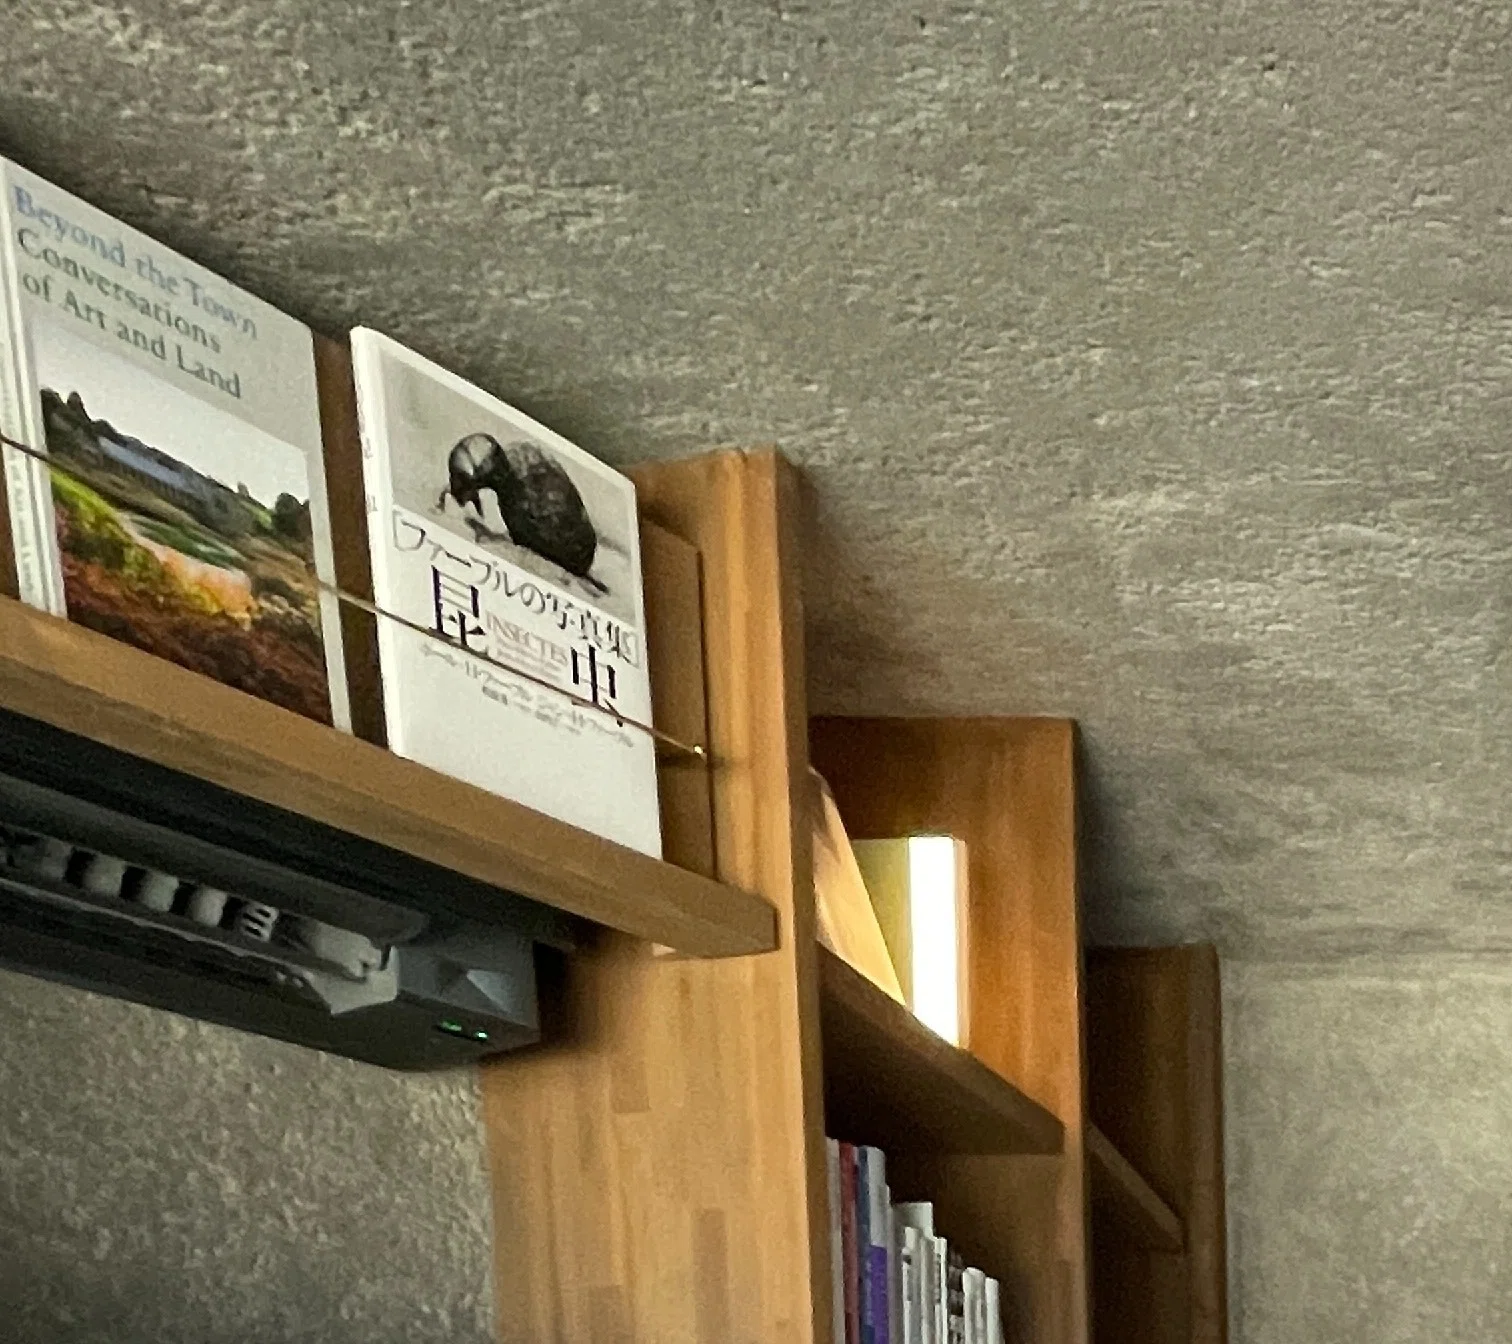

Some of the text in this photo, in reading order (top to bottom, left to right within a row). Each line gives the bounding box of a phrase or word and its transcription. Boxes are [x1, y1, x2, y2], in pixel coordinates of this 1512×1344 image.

[13, 185, 257, 340] Beyond the Town
[17, 228, 221, 354] Conversations
[23, 272, 241, 399] of Art and Land
